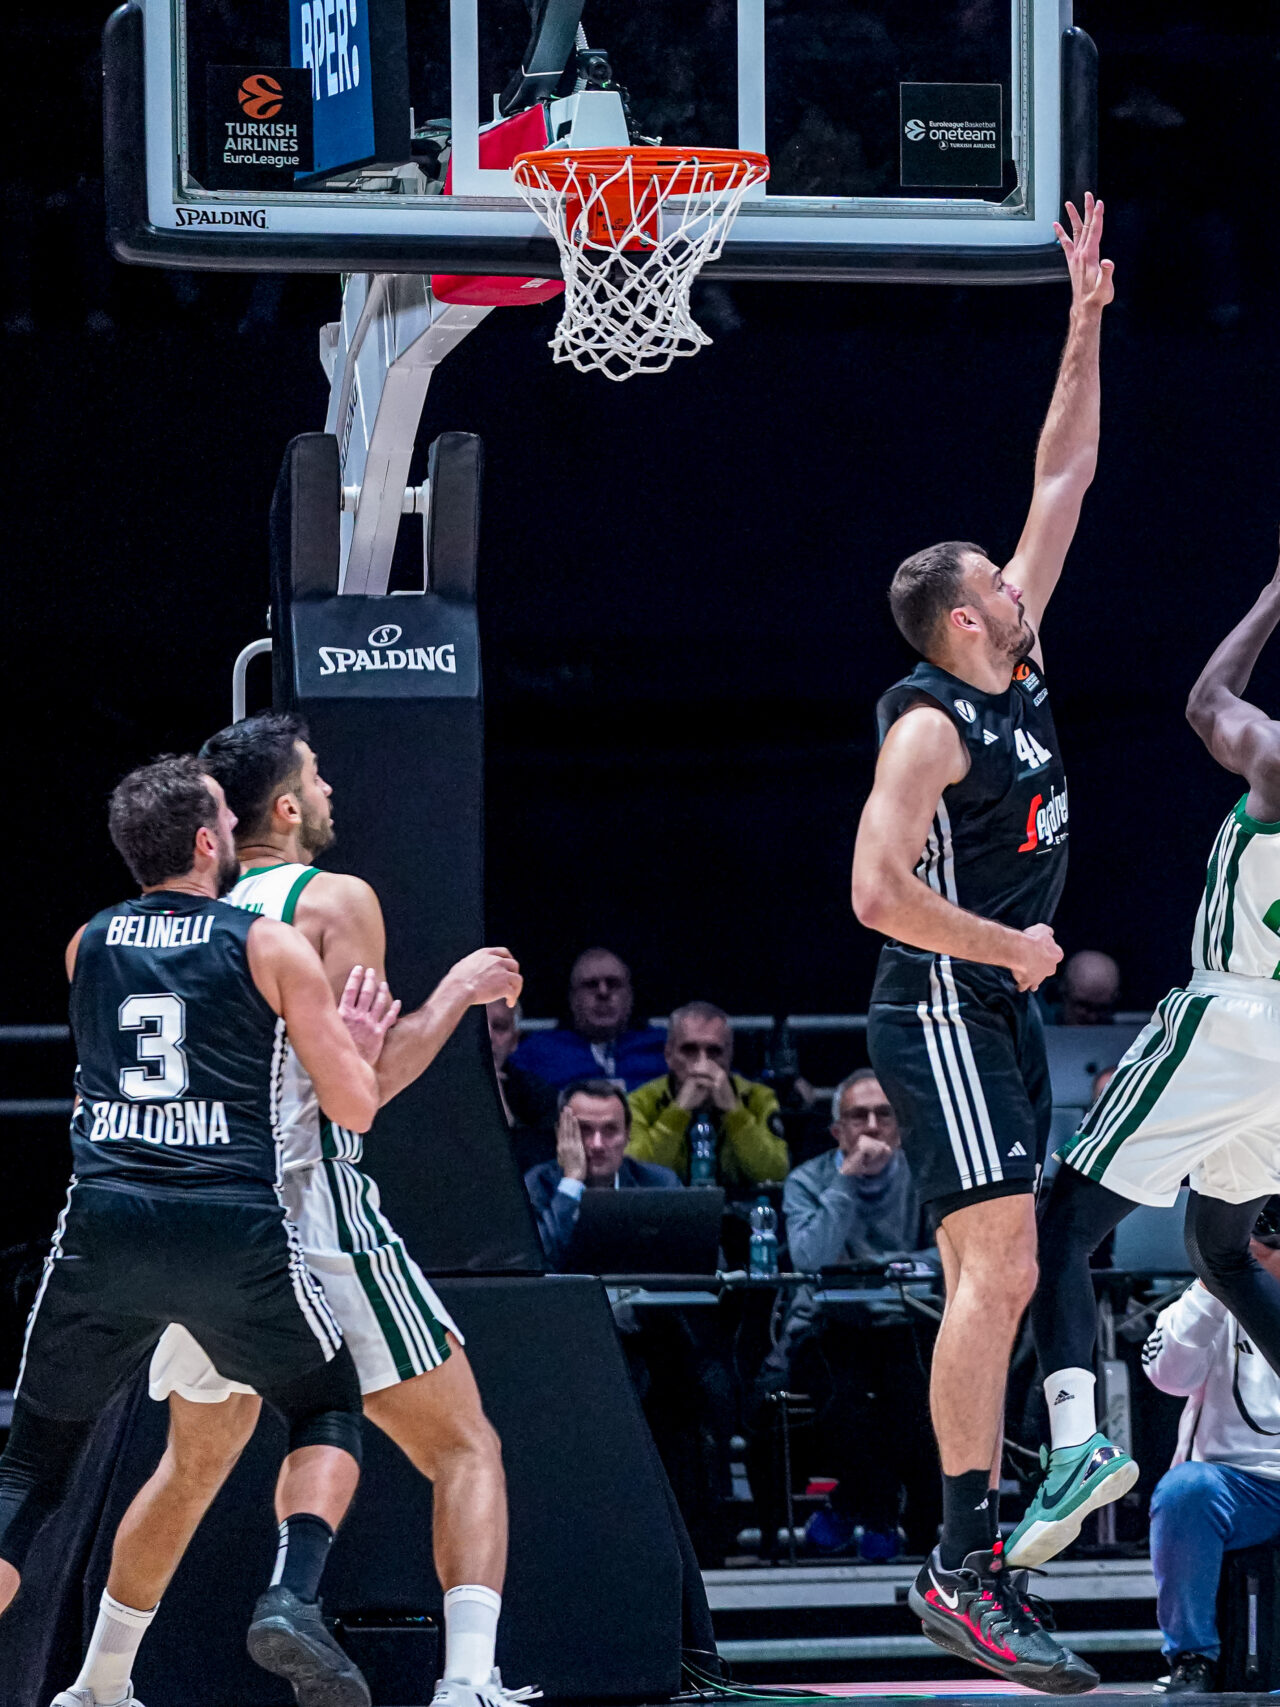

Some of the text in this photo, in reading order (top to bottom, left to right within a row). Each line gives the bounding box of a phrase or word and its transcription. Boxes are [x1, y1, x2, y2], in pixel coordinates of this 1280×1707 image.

[225, 122, 297, 136] TURKISH
[929, 128, 996, 141] oneteam
[224, 138, 299, 151] AIRLINES
[223, 152, 300, 168] EuroLeague
[175, 207, 268, 229] SPALDING
[319, 644, 457, 676] SPALDING
[105, 915, 215, 948] BELINELLI
[118, 992, 189, 1100] 3
[89, 1101, 230, 1145] BOLOGNA
